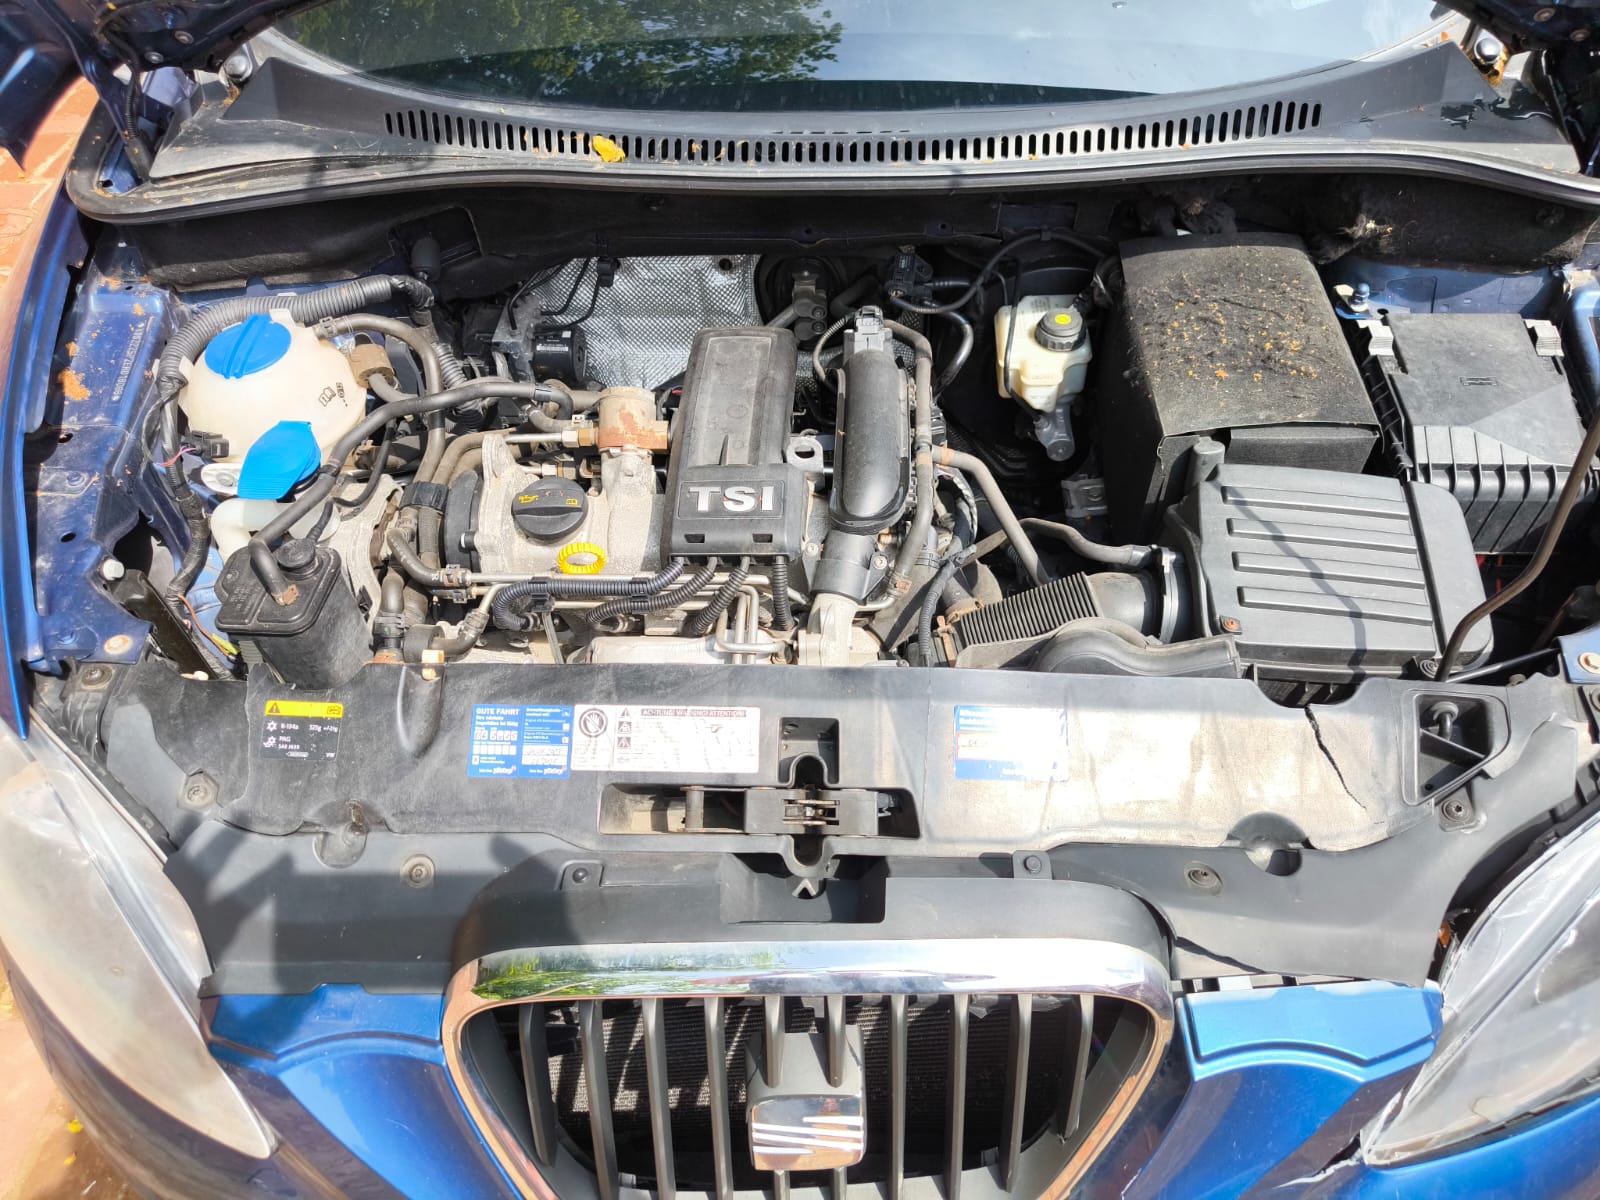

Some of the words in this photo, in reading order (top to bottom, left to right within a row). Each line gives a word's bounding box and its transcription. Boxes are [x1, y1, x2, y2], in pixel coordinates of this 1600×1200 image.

[689, 486, 775, 512] TSI
[476, 707, 495, 715] GUTE
[496, 708, 520, 716] FAHRT
